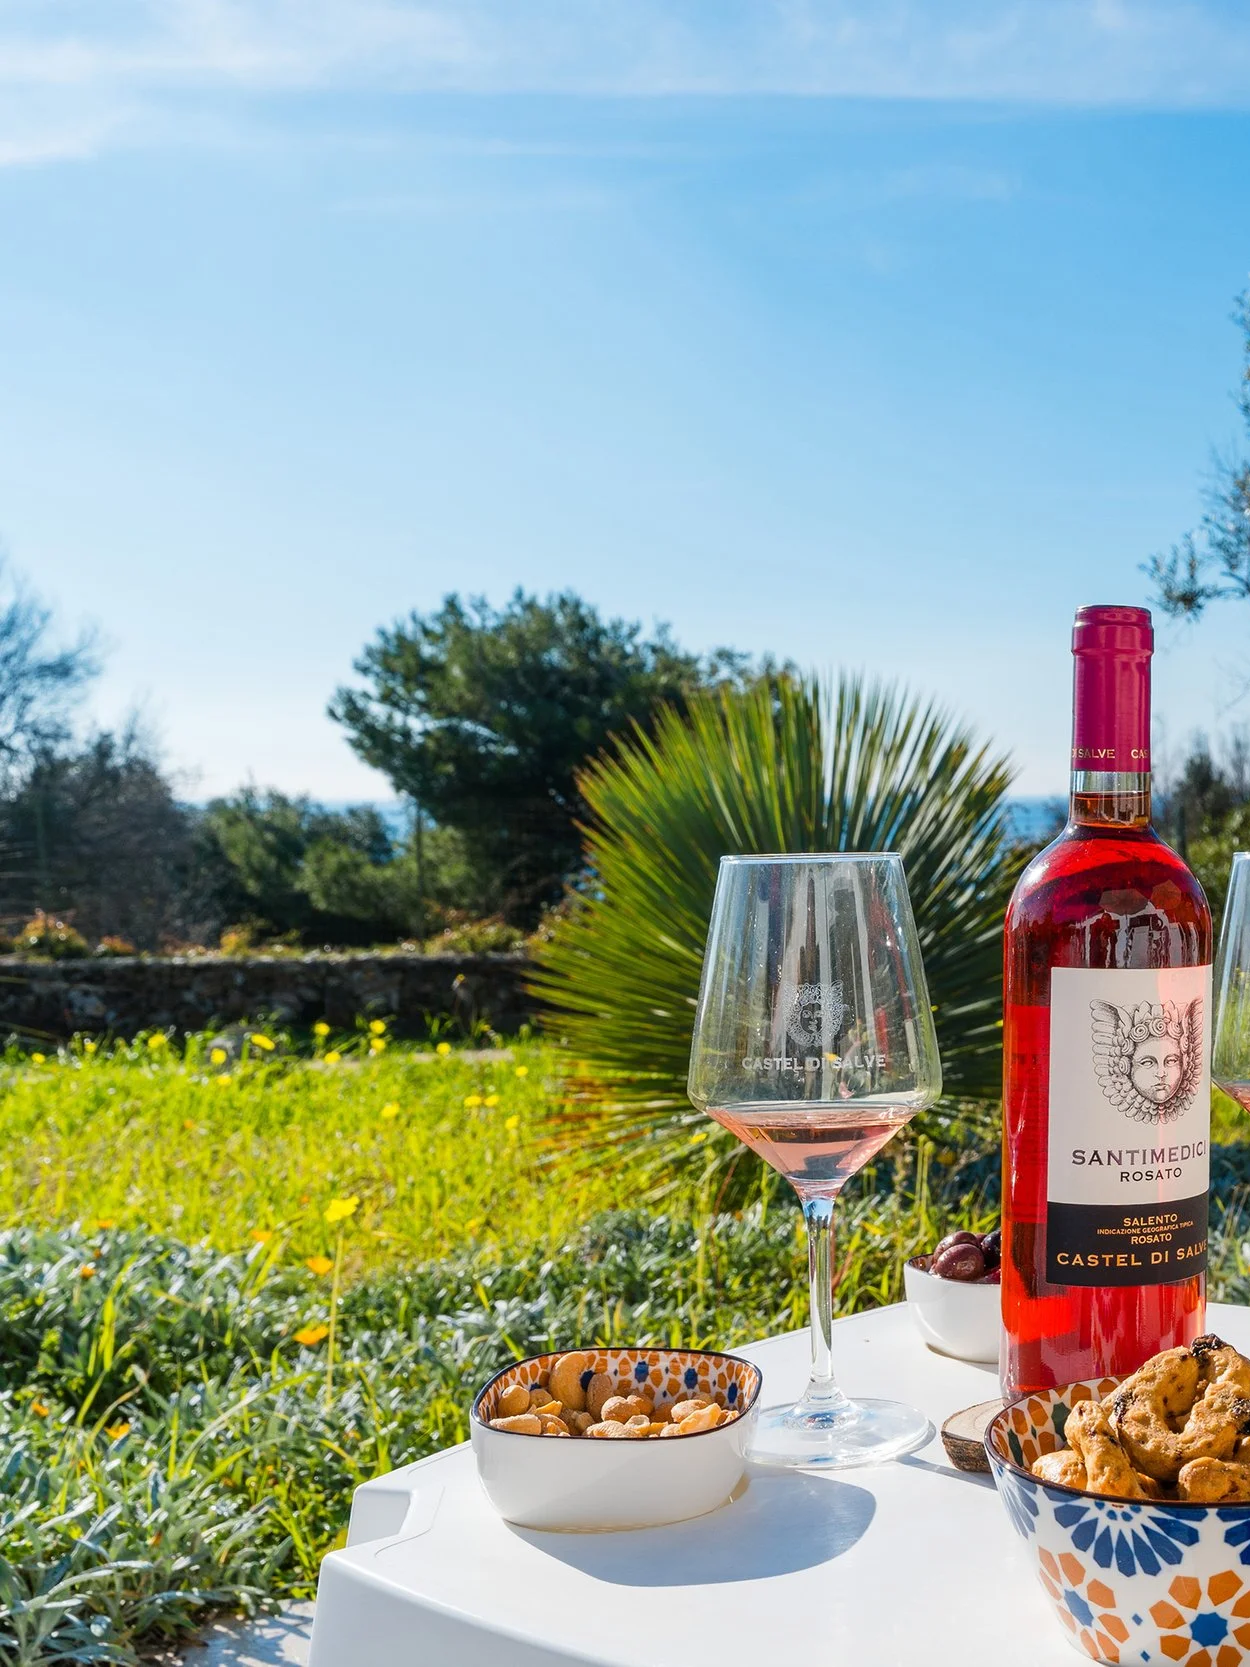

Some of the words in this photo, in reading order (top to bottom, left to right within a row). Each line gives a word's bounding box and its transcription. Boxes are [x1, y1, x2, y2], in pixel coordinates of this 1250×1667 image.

[1078, 748, 1116, 759] SALVE
[741, 1057, 804, 1071] CASTEL
[809, 1056, 825, 1070] DI
[832, 1054, 887, 1070] SALVE
[1072, 1140, 1207, 1166] SANTIMEDICI
[1120, 1167, 1182, 1182] ROSATO
[1123, 1213, 1178, 1227] SALENTO
[1097, 1228, 1141, 1236] INDICAZIONE
[1142, 1223, 1179, 1234] GEOGRAFICA
[1179, 1220, 1194, 1229] TIPICA
[1131, 1232, 1172, 1245] ROSATO
[1056, 1252, 1142, 1267] CASTEL
[1151, 1250, 1169, 1265] DI
[1176, 1239, 1208, 1261] SALVE
